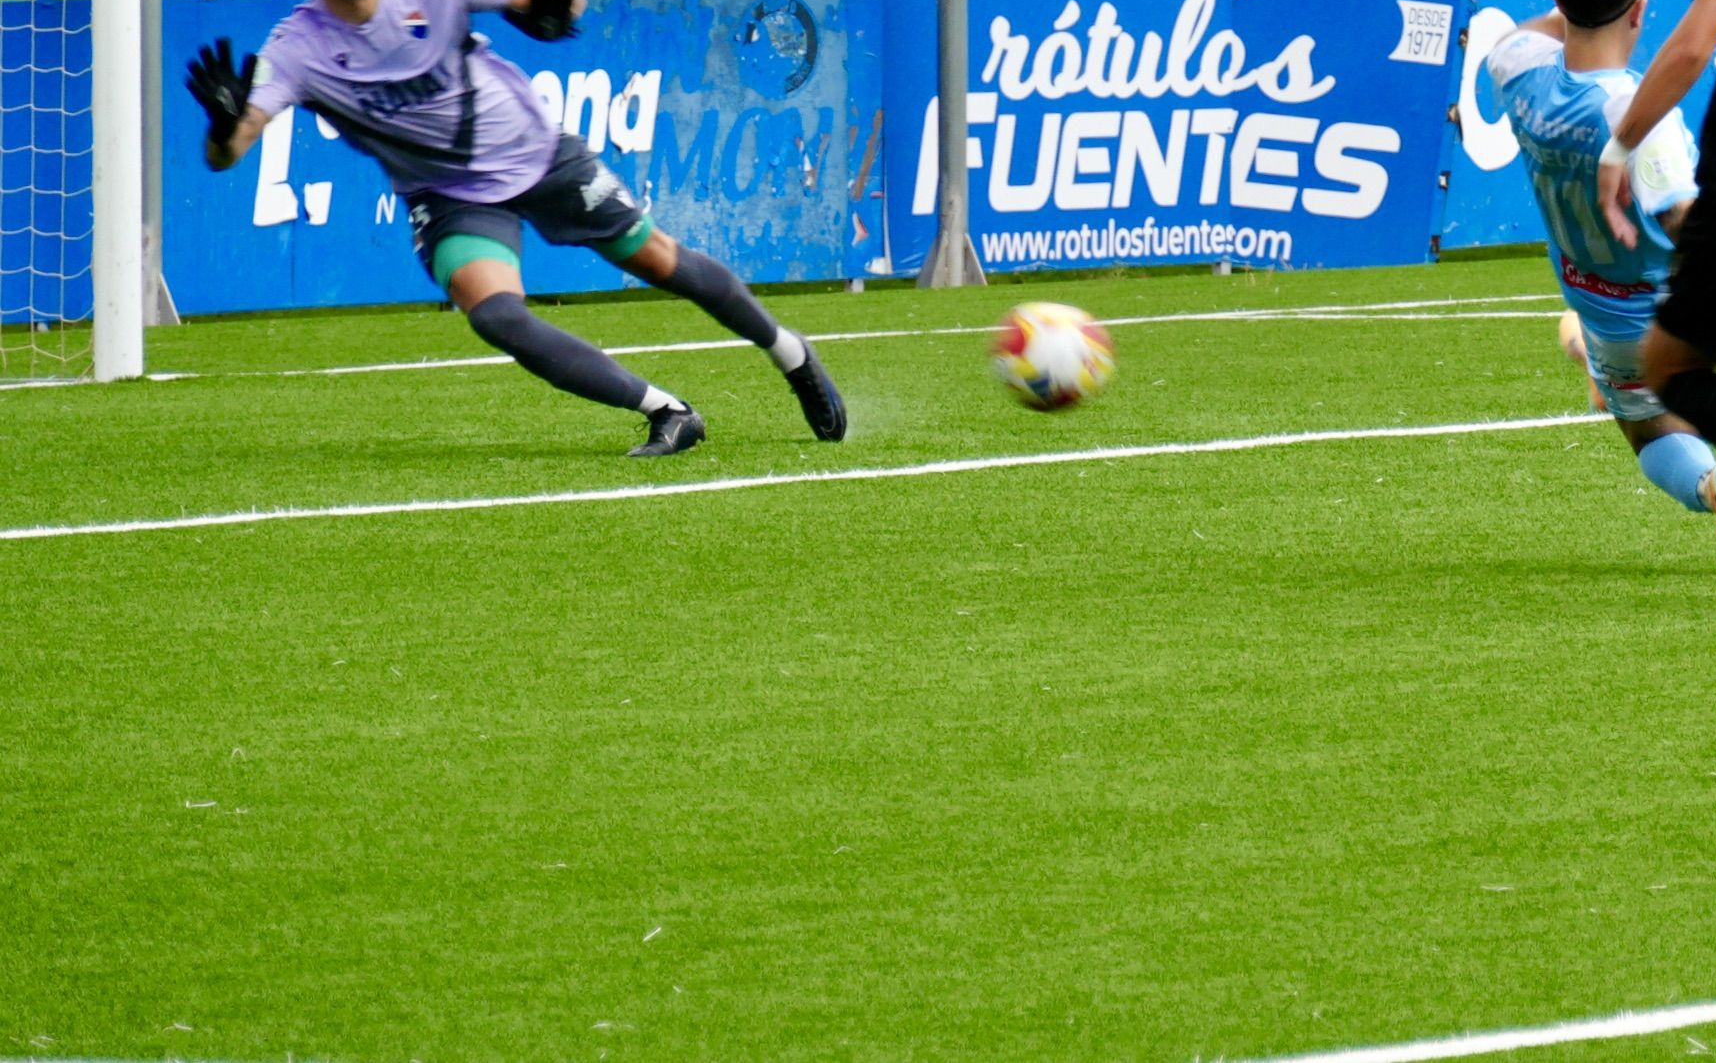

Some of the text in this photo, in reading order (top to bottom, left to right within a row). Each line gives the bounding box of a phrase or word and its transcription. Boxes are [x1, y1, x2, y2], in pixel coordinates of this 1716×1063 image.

[1407, 7, 1447, 29] DESDE
[1406, 29, 1443, 58] 1977
[912, 92, 1401, 220] FUENTES
